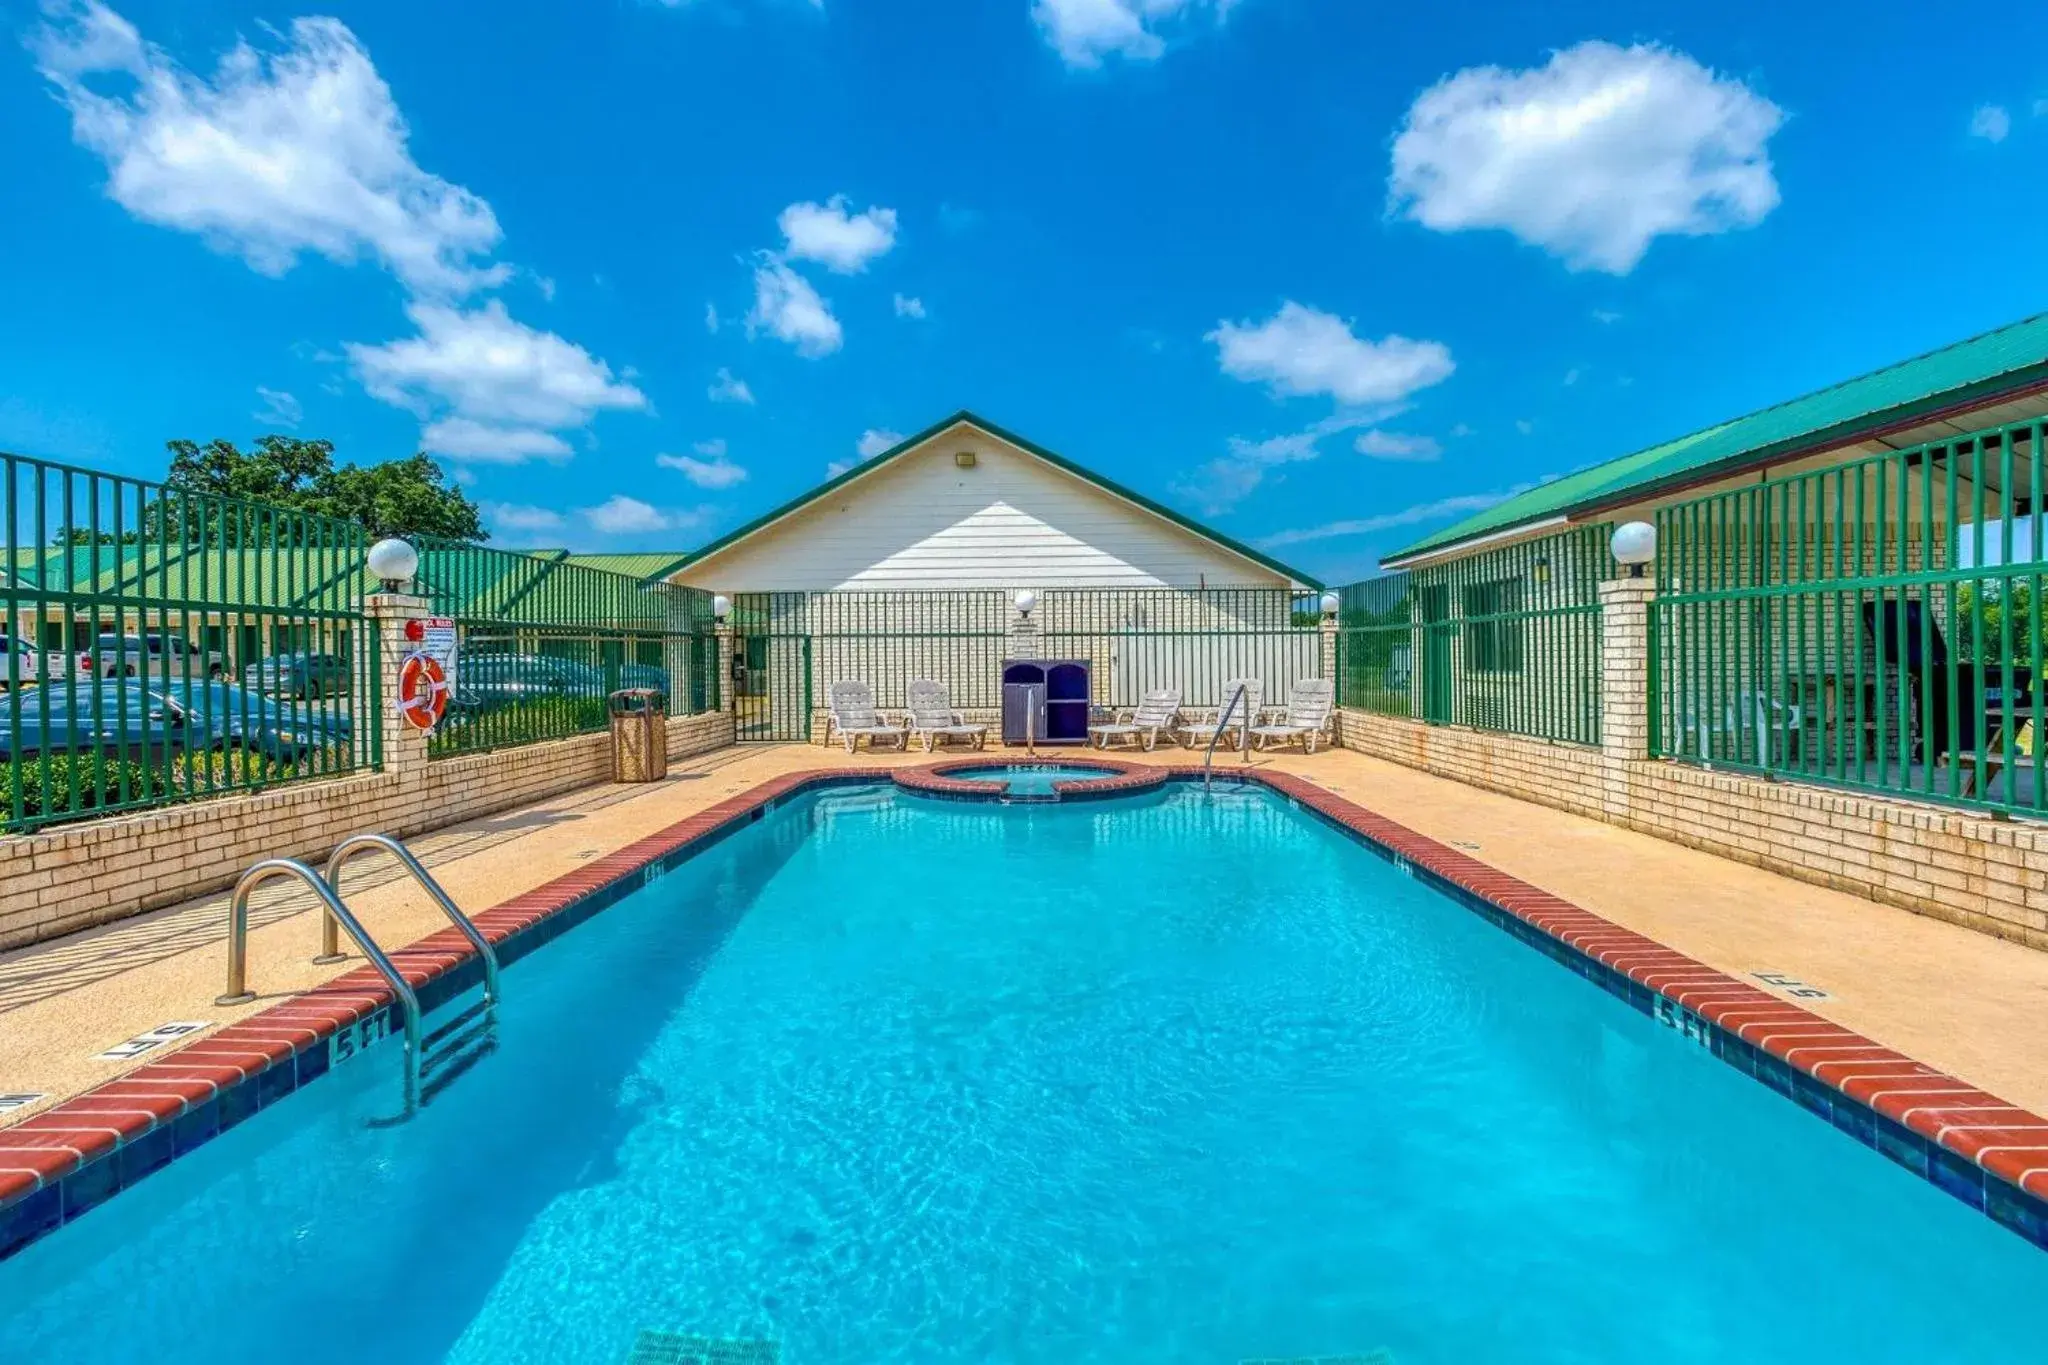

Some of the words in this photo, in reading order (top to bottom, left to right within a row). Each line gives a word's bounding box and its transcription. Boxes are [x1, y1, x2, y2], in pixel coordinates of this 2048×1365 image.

[1750, 973, 1803, 986] FT
[153, 1025, 199, 1036] 5
[1660, 998, 1677, 1029] 5
[1682, 1008, 1708, 1048] FT
[336, 1027, 354, 1065] 5
[361, 1008, 388, 1050] FT
[101, 1040, 165, 1059] FT
